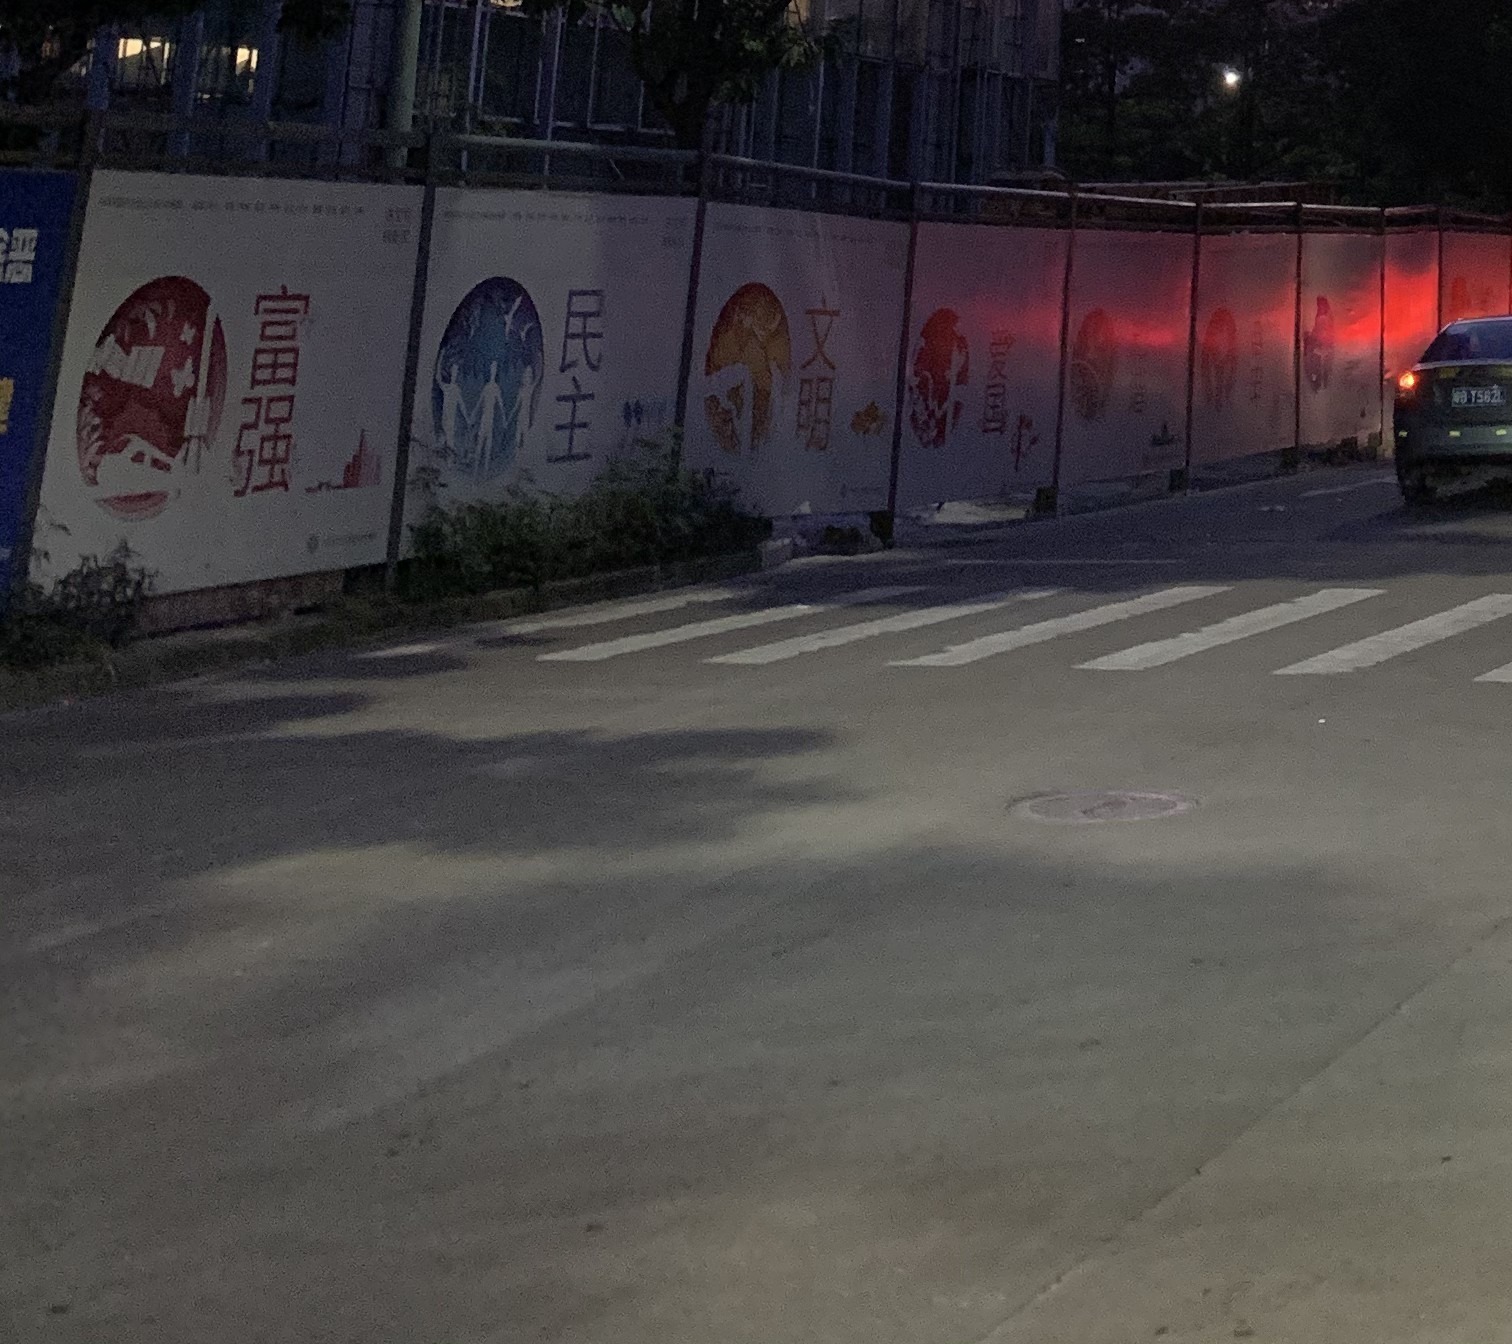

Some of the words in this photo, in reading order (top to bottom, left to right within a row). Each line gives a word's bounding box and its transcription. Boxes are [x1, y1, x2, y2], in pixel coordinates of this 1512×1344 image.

[232, 285, 311, 498] 富强
[546, 288, 607, 464] 民主
[794, 295, 841, 451] 文明
